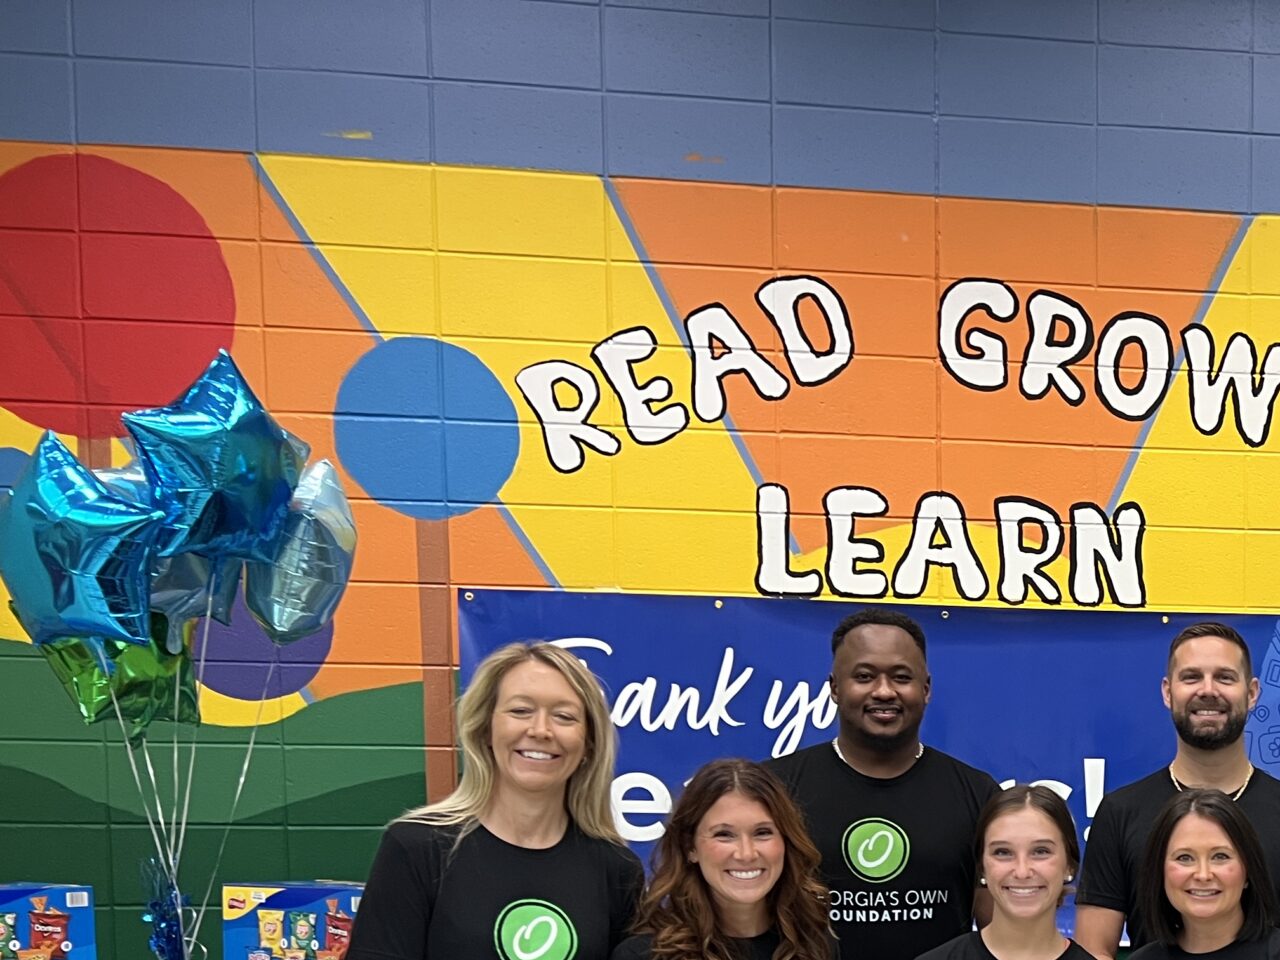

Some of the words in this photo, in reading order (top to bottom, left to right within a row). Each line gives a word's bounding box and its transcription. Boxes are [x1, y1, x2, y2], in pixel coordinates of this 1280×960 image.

[515, 274, 854, 474] READ
[755, 482, 1147, 607] LEARN
[763, 680, 838, 758] yo
[829, 890, 899, 907] ORGIA'S
[905, 890, 948, 904] OWN
[829, 908, 933, 922] OUNDATION
